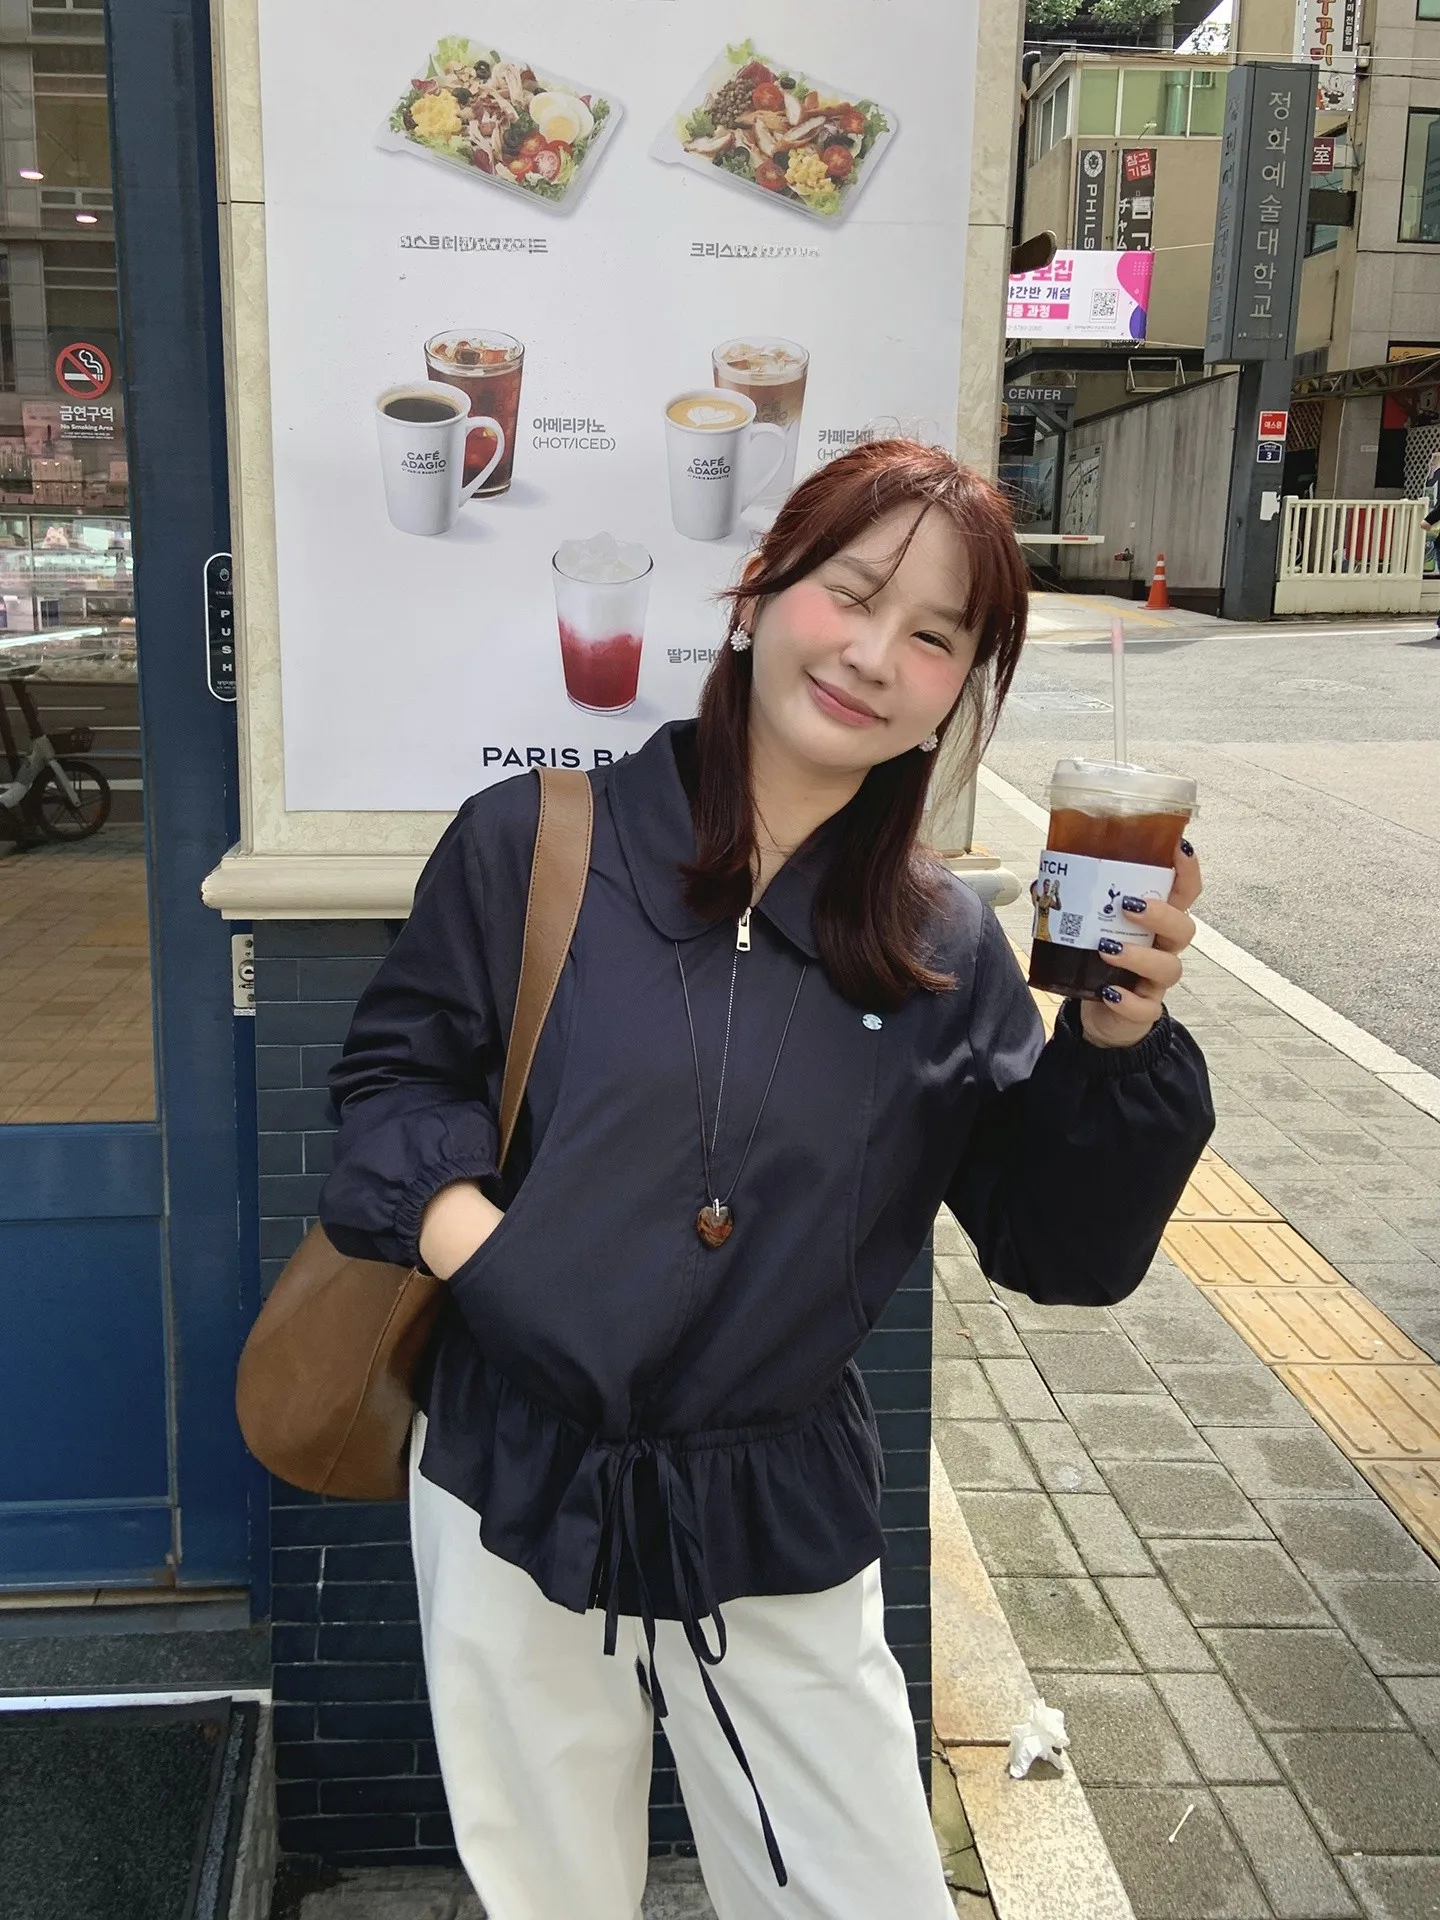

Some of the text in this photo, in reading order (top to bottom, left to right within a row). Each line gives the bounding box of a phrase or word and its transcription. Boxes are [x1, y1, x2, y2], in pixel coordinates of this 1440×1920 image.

[1126, 152, 1150, 167] 참고
[1312, 144, 1331, 165] 室
[1128, 163, 1151, 177] 기집
[1249, 91, 1292, 319] 정화예술대학교
[1046, 287, 1071, 300] 개설
[1027, 304, 1050, 319] 과정
[1008, 388, 1061, 400] CENTER
[60, 405, 114, 423] 금연구역
[71, 424, 98, 432] Smoking
[532, 417, 606, 434] 아메리카노
[532, 436, 617, 452] (HOT/ICED)
[406, 450, 440, 461] CAFÉ
[692, 456, 725, 467] CAFÉ
[1266, 451, 1272, 461] 3
[400, 459, 447, 470] ADAGIO
[686, 465, 731, 476] ADAGIO
[220, 609, 233, 673] PUSH
[482, 747, 581, 768] PARIS
